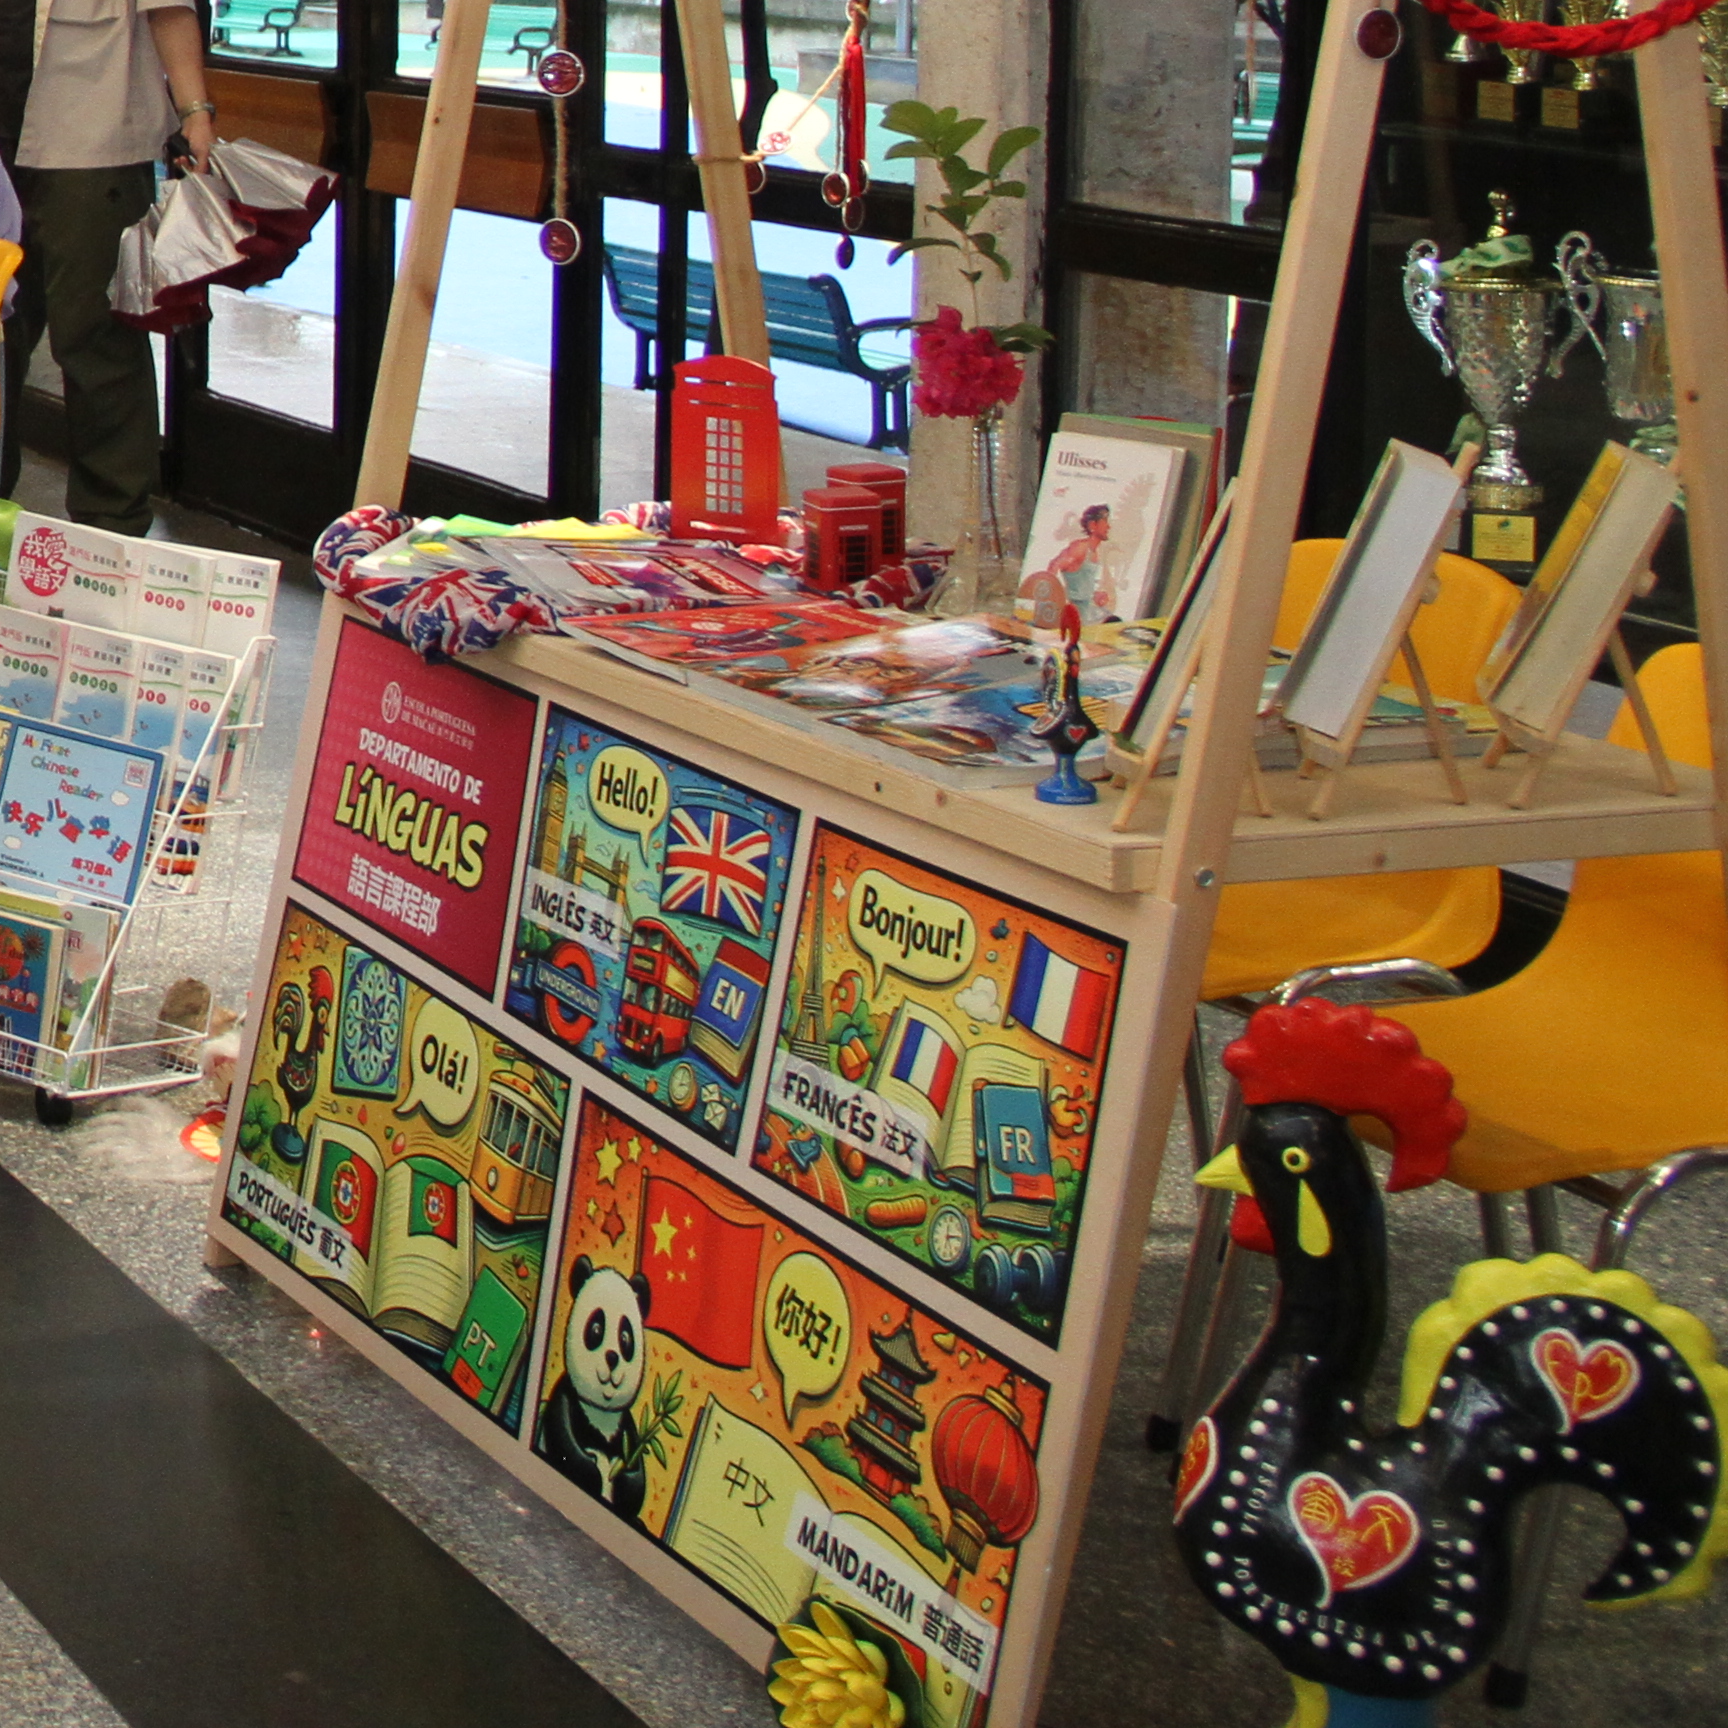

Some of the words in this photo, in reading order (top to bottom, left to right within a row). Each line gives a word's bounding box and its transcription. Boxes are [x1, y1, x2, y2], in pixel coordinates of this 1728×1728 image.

[1058, 450, 1108, 471] Ulisses
[19, 555, 65, 591] 學語文
[24, 531, 69, 569] 我愛
[31, 755, 80, 778] Chinese
[41, 738, 72, 757] First
[359, 727, 461, 793] DEPARTAMENTO
[463, 775, 484, 805] DE
[59, 779, 104, 802] Reader
[597, 761, 659, 819] Hello!
[531, 883, 585, 932] INGLÊS
[590, 911, 616, 945] 英文
[859, 884, 965, 963] Bonjour!
[538, 969, 599, 1013] UNDERGROUND
[711, 977, 746, 1020] EN
[420, 1034, 470, 1096] Olá!
[783, 1072, 876, 1143] FRANCÊS
[882, 1119, 917, 1162] 法文
[999, 1126, 1037, 1164] FR
[238, 1171, 317, 1245] PORTUGUÊS
[318, 1227, 347, 1270] 葡文
[463, 1321, 498, 1368] PT
[723, 1458, 776, 1527] 中文
[1240, 1461, 1280, 1536] ESCOLA
[1432, 1519, 1453, 1613] MACAU
[1234, 1556, 1385, 1647] PORTUGUESA
[921, 1603, 985, 1673] 普通話
[1404, 1629, 1437, 1652] DE
